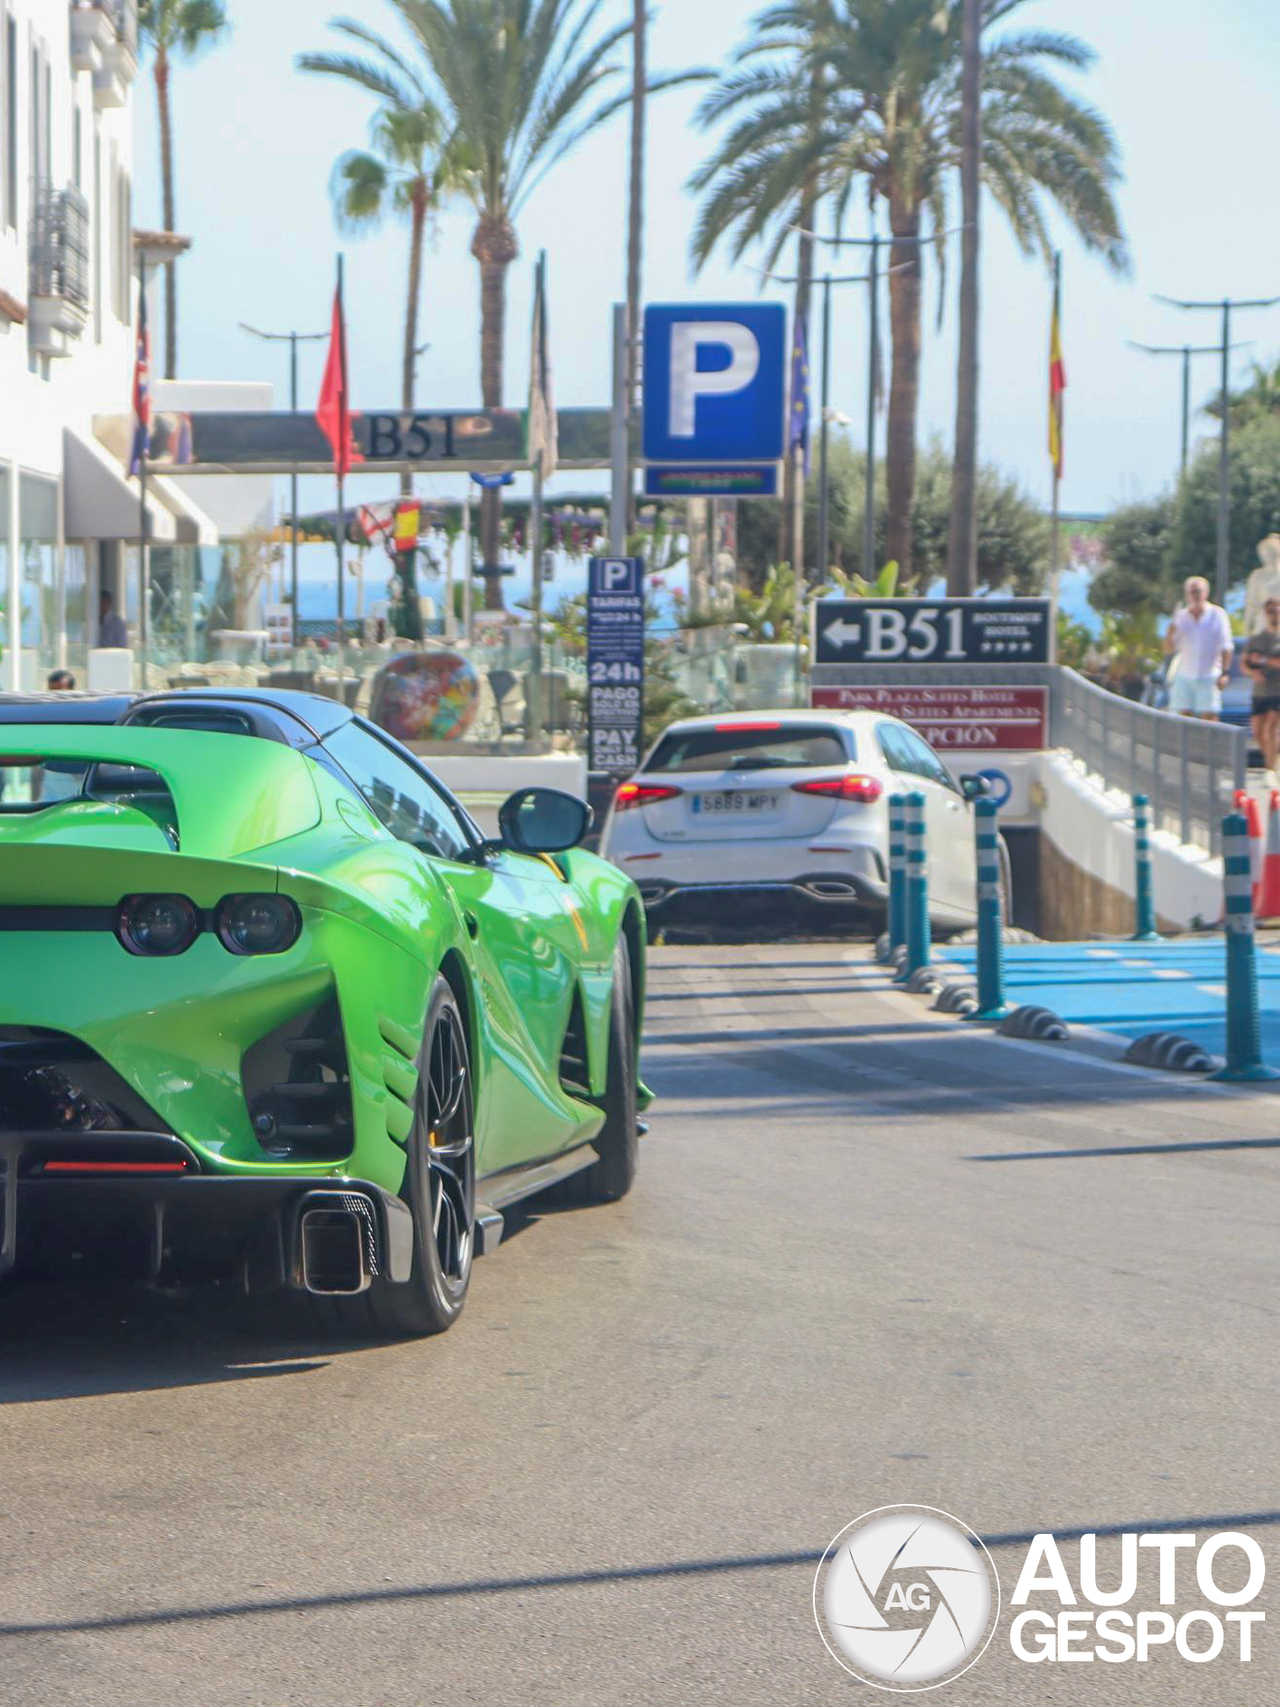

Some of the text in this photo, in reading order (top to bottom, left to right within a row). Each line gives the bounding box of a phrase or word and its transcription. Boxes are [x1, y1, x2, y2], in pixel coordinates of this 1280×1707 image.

[670, 321, 760, 437] P
[365, 413, 458, 458] B51
[604, 561, 629, 590] P
[591, 597, 641, 607] TARIFAS
[972, 612, 1043, 623] BOUTIQUE
[863, 608, 968, 659] B51
[984, 626, 1031, 636] HOTEL
[591, 661, 641, 681] 24h
[591, 686, 640, 700] PAGO
[593, 729, 637, 744] PAY
[921, 723, 999, 743] PCIÓN
[593, 754, 638, 766] CASH
